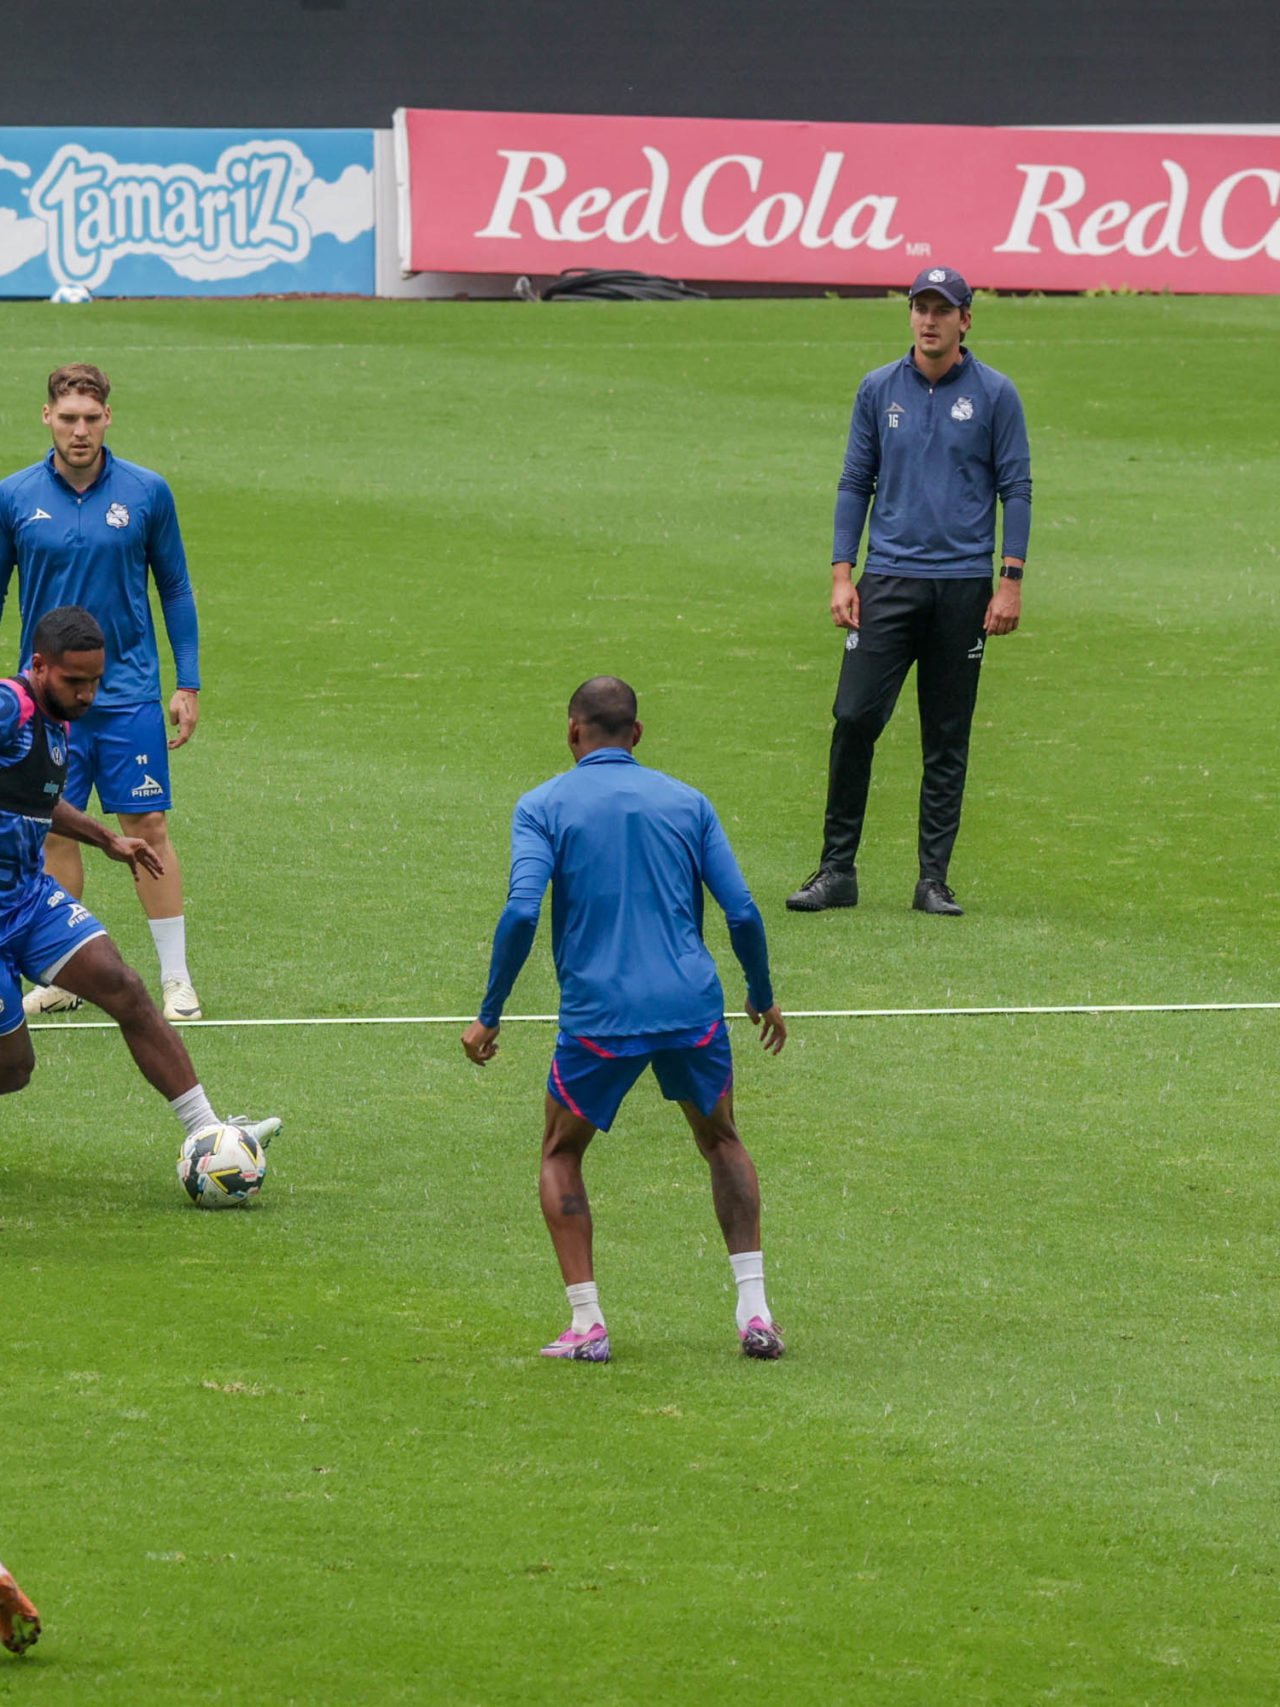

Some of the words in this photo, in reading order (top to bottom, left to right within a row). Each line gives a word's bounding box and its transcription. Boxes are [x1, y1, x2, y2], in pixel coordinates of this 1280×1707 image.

[888, 414, 899, 428] 16
[135, 754, 148, 765] 11
[131, 788, 163, 797] PIRMA
